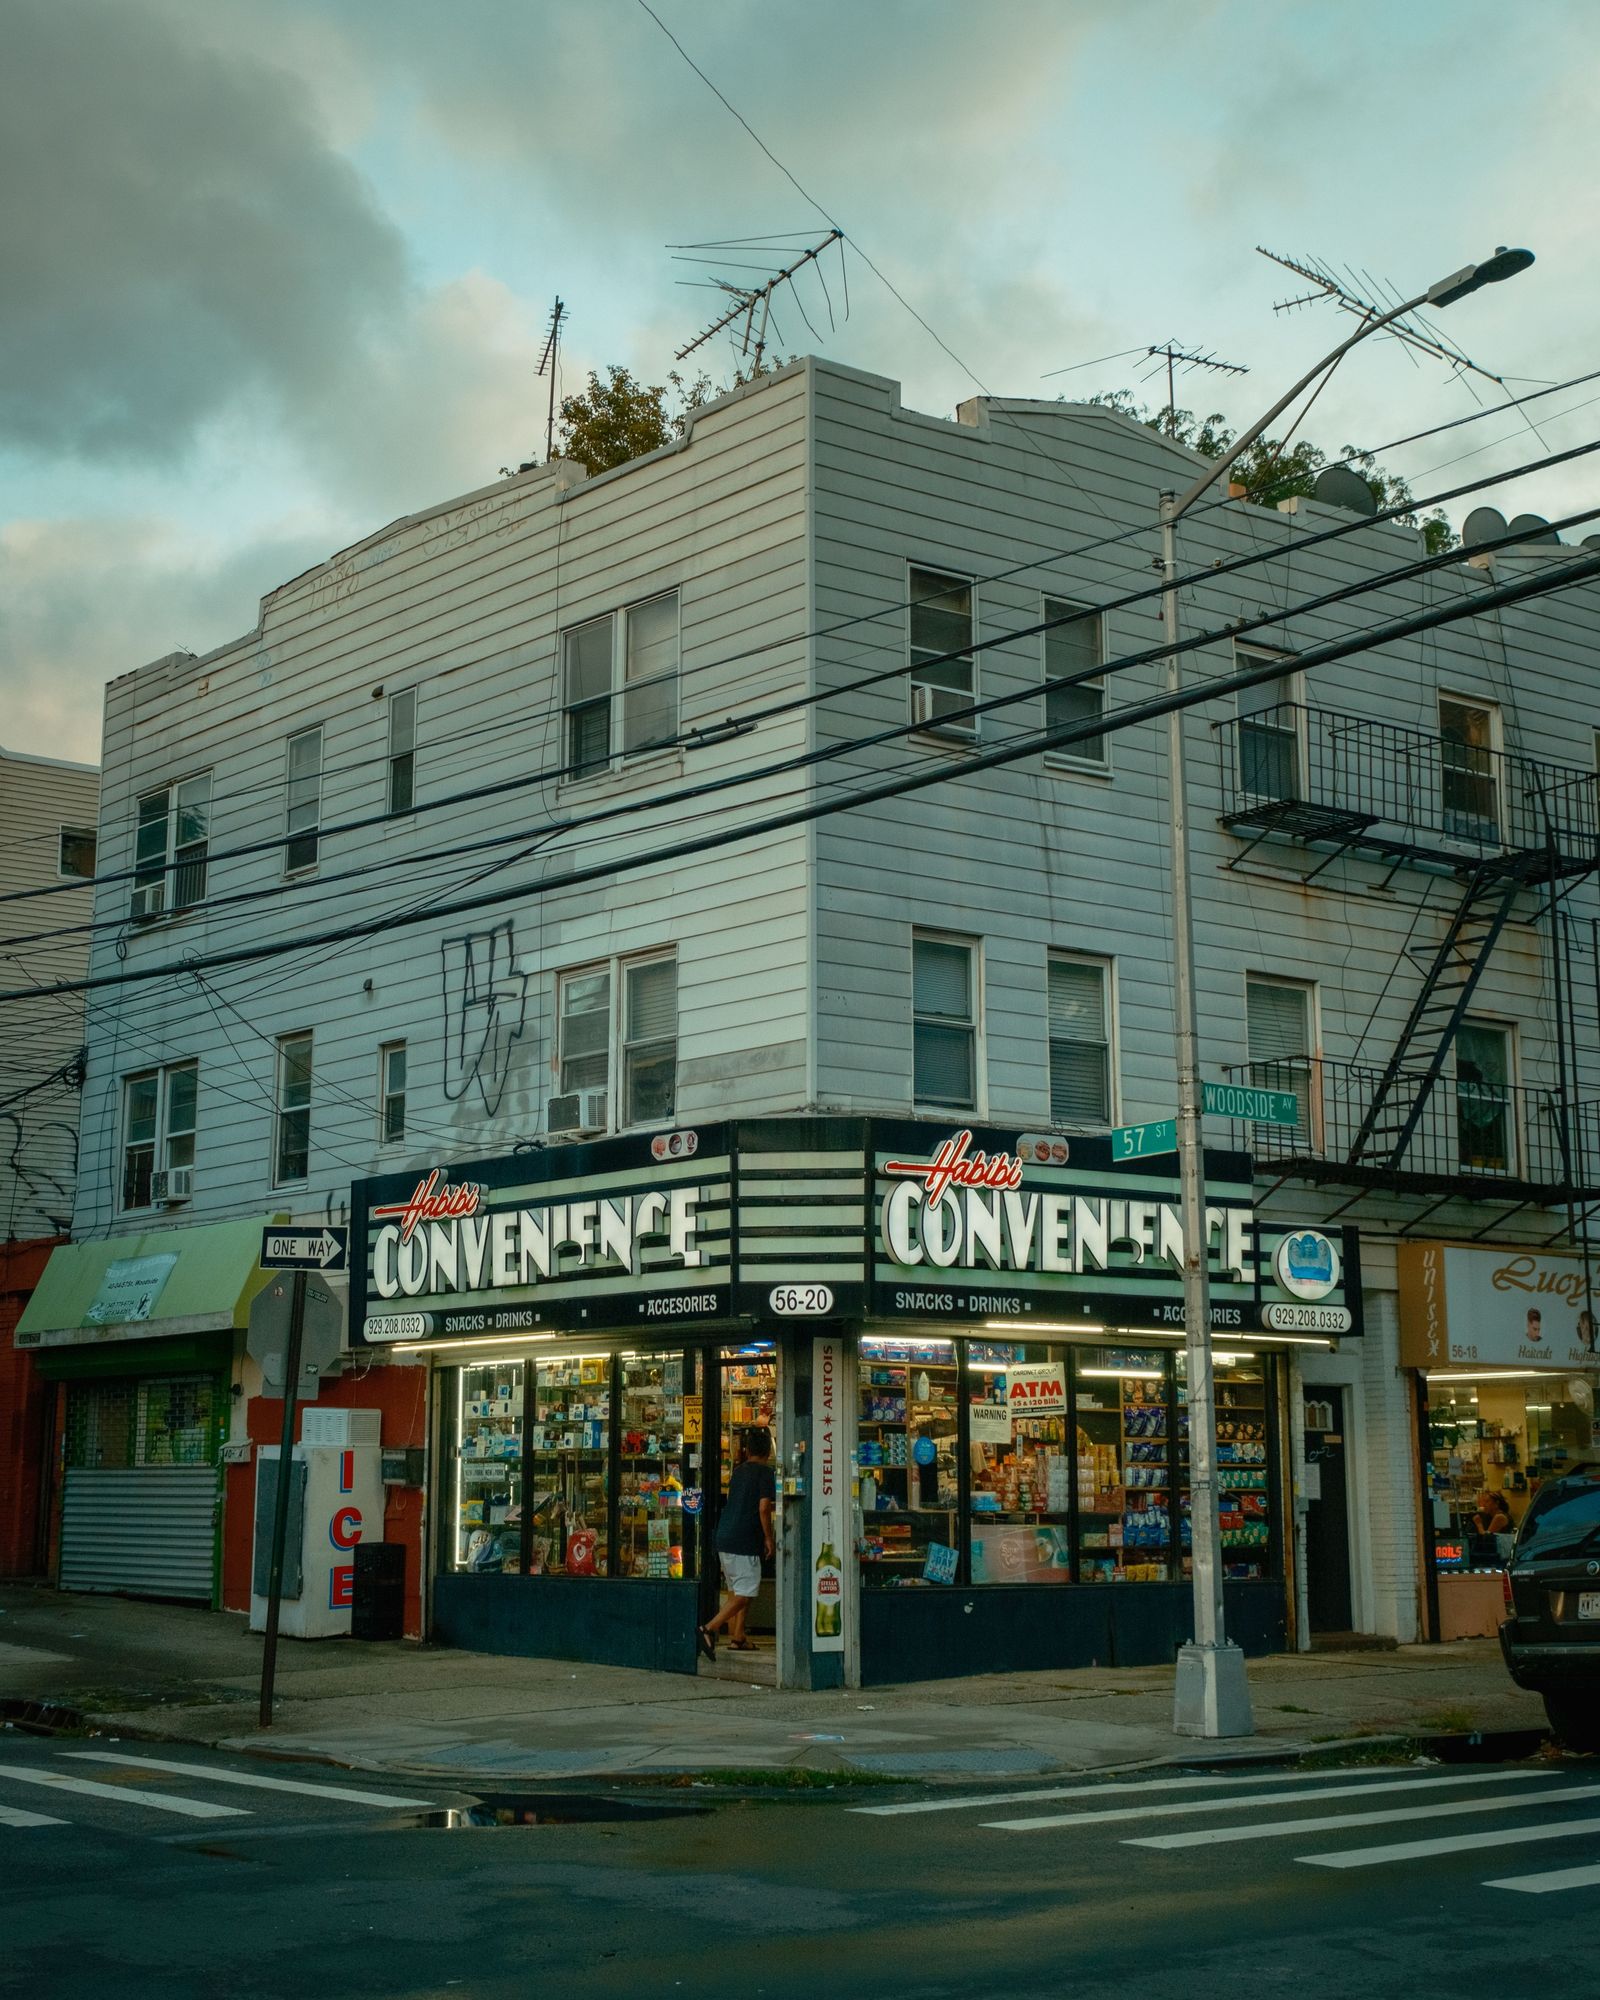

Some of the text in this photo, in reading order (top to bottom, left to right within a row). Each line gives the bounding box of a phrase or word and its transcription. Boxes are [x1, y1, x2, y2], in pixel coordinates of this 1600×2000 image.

[1205, 1086, 1293, 1119] WOODSIDE AV
[1123, 1124, 1168, 1155] 57 ST
[884, 1129, 1024, 1210] Habibi
[373, 1168, 483, 1245] Habibi
[273, 1240, 334, 1256] ONE WAY
[445, 1295, 717, 1332] SNACKS DRINKS ACCESORIES
[775, 1289, 828, 1311] 56-20
[896, 1292, 1241, 1325] SNACKS DRINKS ACCRIES
[368, 1315, 421, 1334] 929.208.0332
[1275, 1307, 1344, 1329] 929.208.0332
[1452, 1345, 1478, 1359] 56-18
[1010, 1381, 1063, 1399] ATM
[822, 1345, 833, 1496] STELLA ARTOIS
[973, 1408, 1007, 1420] WARNING
[329, 1450, 363, 1610] ICE
